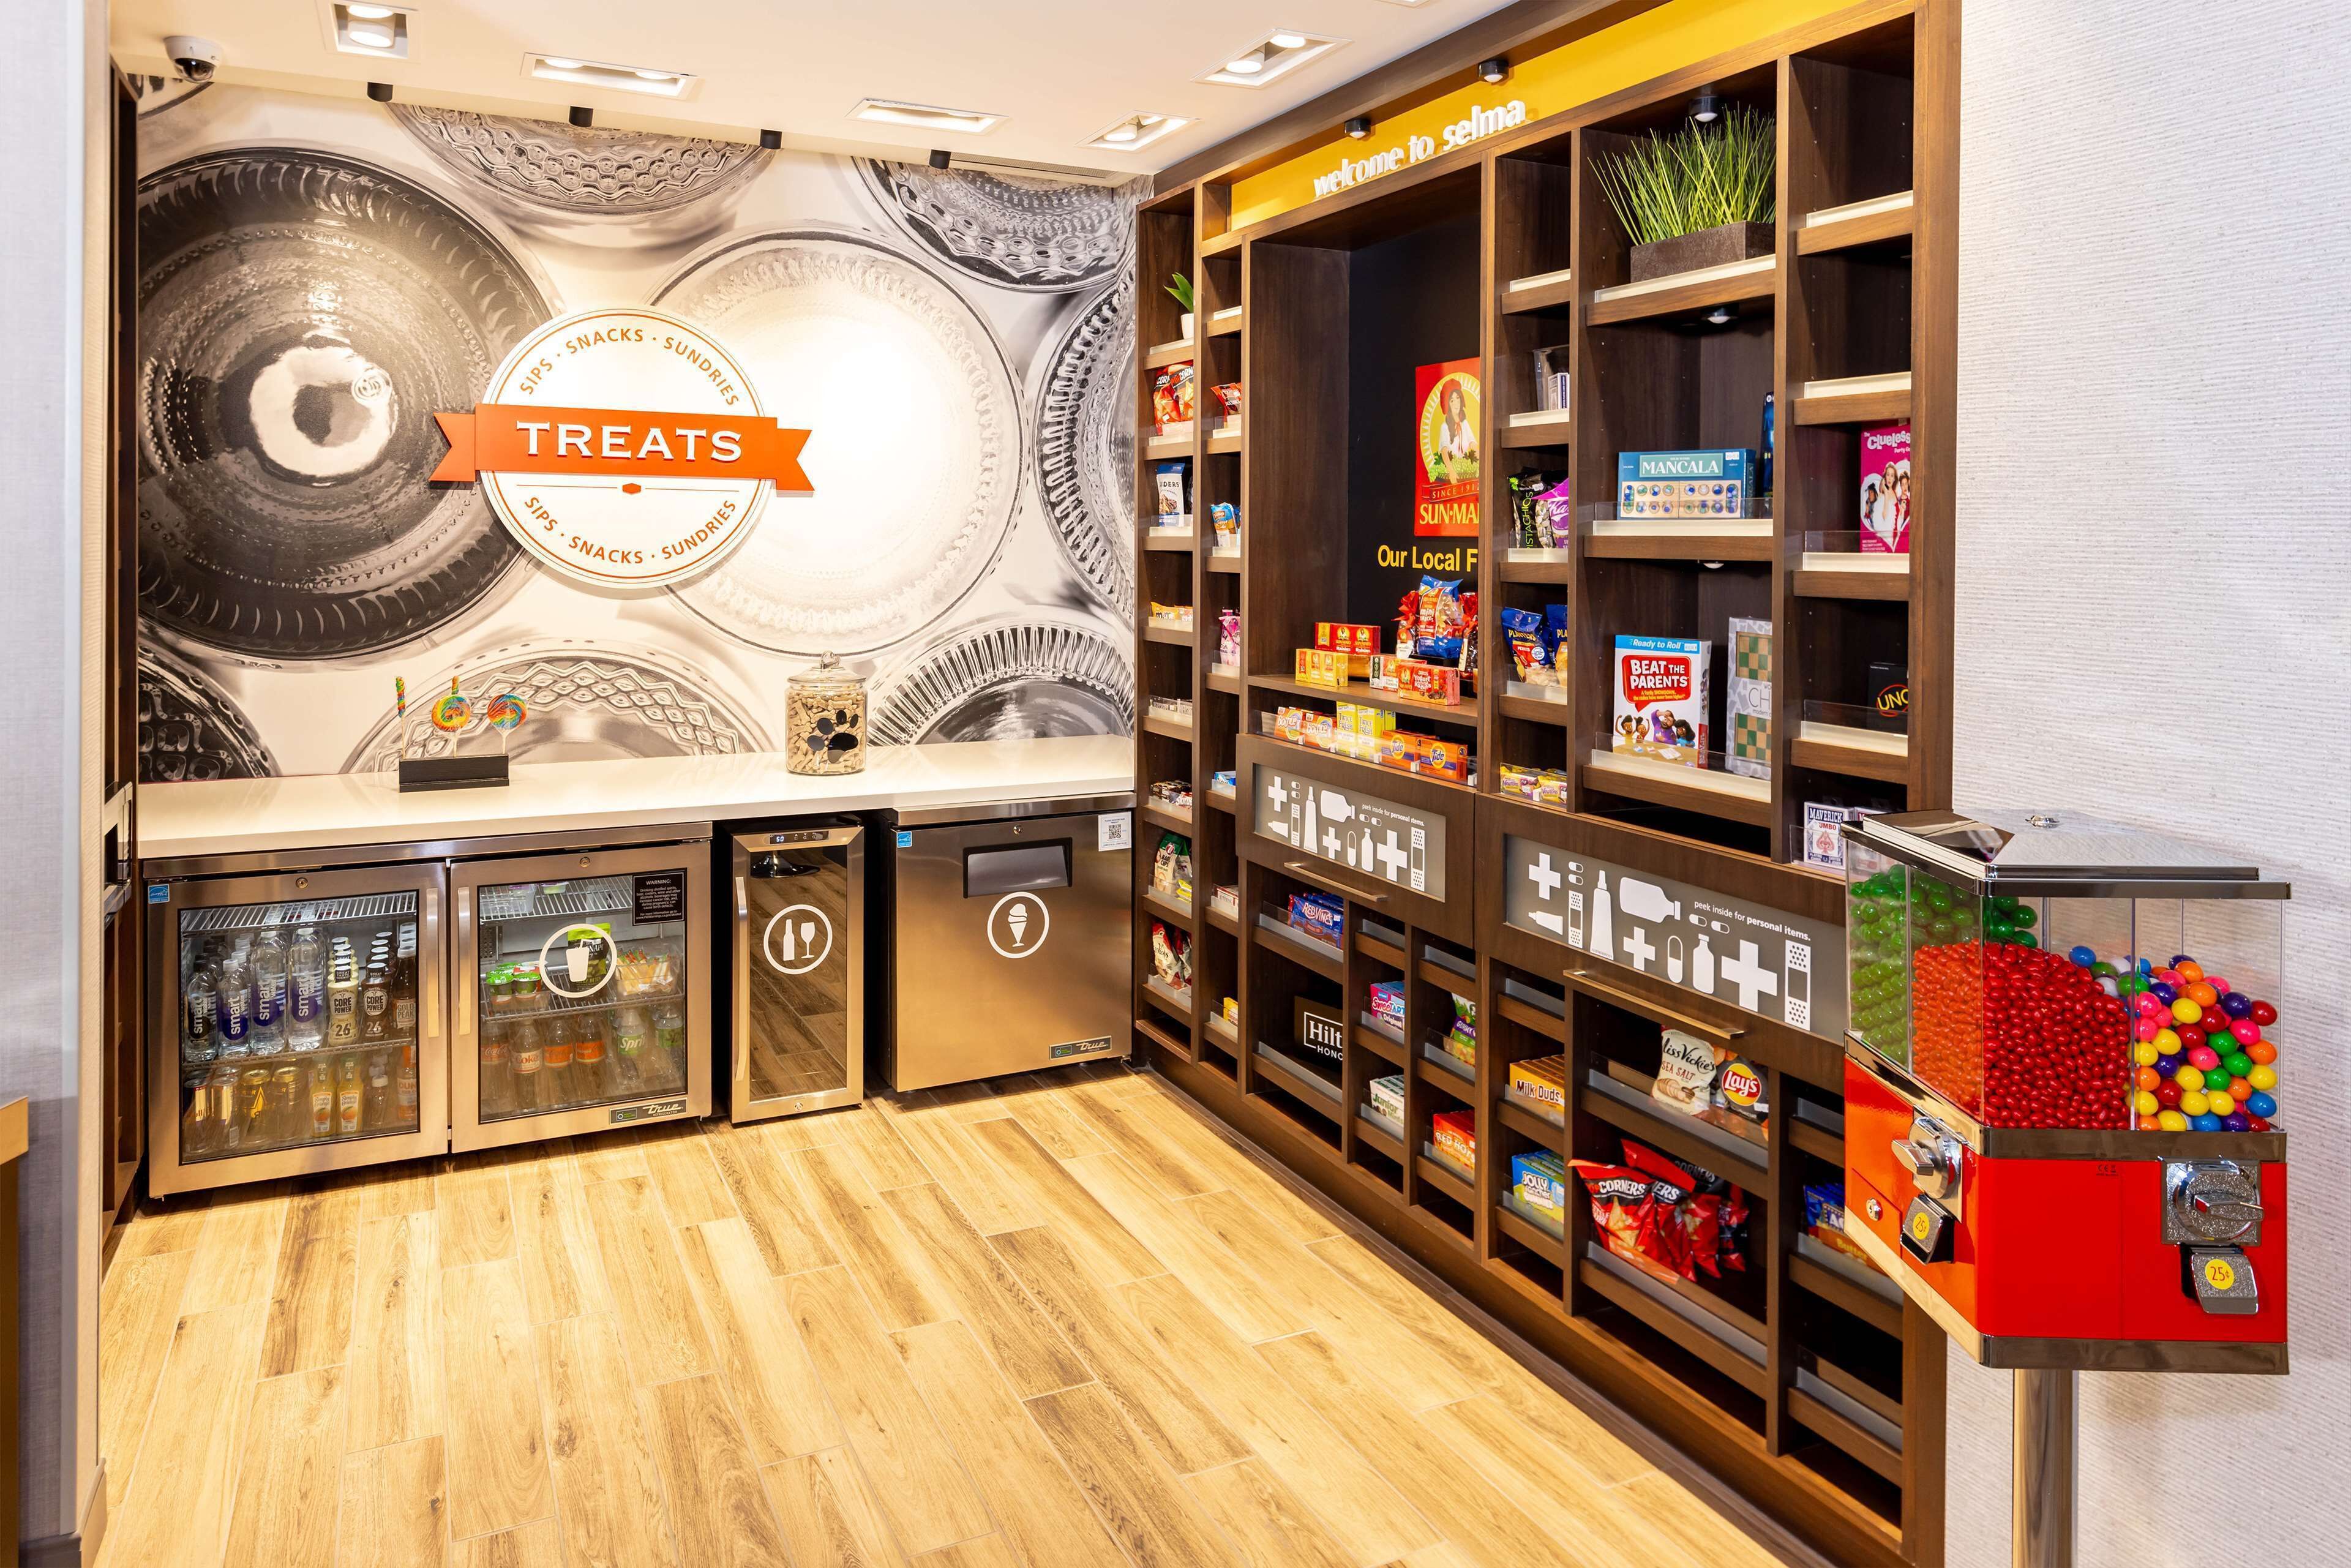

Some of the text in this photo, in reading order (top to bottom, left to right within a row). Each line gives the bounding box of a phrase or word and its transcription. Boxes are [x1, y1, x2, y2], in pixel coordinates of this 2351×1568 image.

[1313, 100, 1526, 198] welcome to selma
[520, 328, 740, 406] SIPS SNACKS SUNDRIES
[516, 421, 742, 462] TREATS
[1642, 460, 1719, 474] MANCALA
[1433, 487, 1457, 498] SINCE
[524, 497, 737, 564] SIPS SNACKS SUNDRIES
[1378, 545, 1408, 568] Our
[1412, 546, 1460, 571] Local
[1633, 639, 1655, 649] Ready
[1630, 659, 1685, 675] BEAT THE
[1630, 675, 1687, 689] PARENTS
[1392, 740, 1403, 753] Tide
[1431, 749, 1444, 762] Tide
[1372, 806, 1384, 814] inside
[1390, 812, 1410, 822] personal
[1809, 808, 1843, 823] MAVERICK
[1694, 901, 1811, 941] peek inside for personal items.
[258, 979, 270, 1020] smart
[296, 976, 309, 1016] smart
[334, 997, 351, 1007] CORE
[367, 995, 383, 1005] CORE
[228, 996, 241, 1035] smart
[1076, 1041, 1107, 1051] true
[1681, 1044, 1715, 1074] Vickie's
[1662, 1060, 1695, 1081] SEA SALT
[1516, 1079, 1562, 1103] Milk Duds
[1725, 1070, 1758, 1097] Lay's
[642, 1104, 681, 1114] true
[1373, 1093, 1399, 1114] Junior
[1436, 1131, 1452, 1144] RED
[1523, 1171, 1549, 1191] JOLLY
[2210, 1266, 2230, 1281] 25¢
